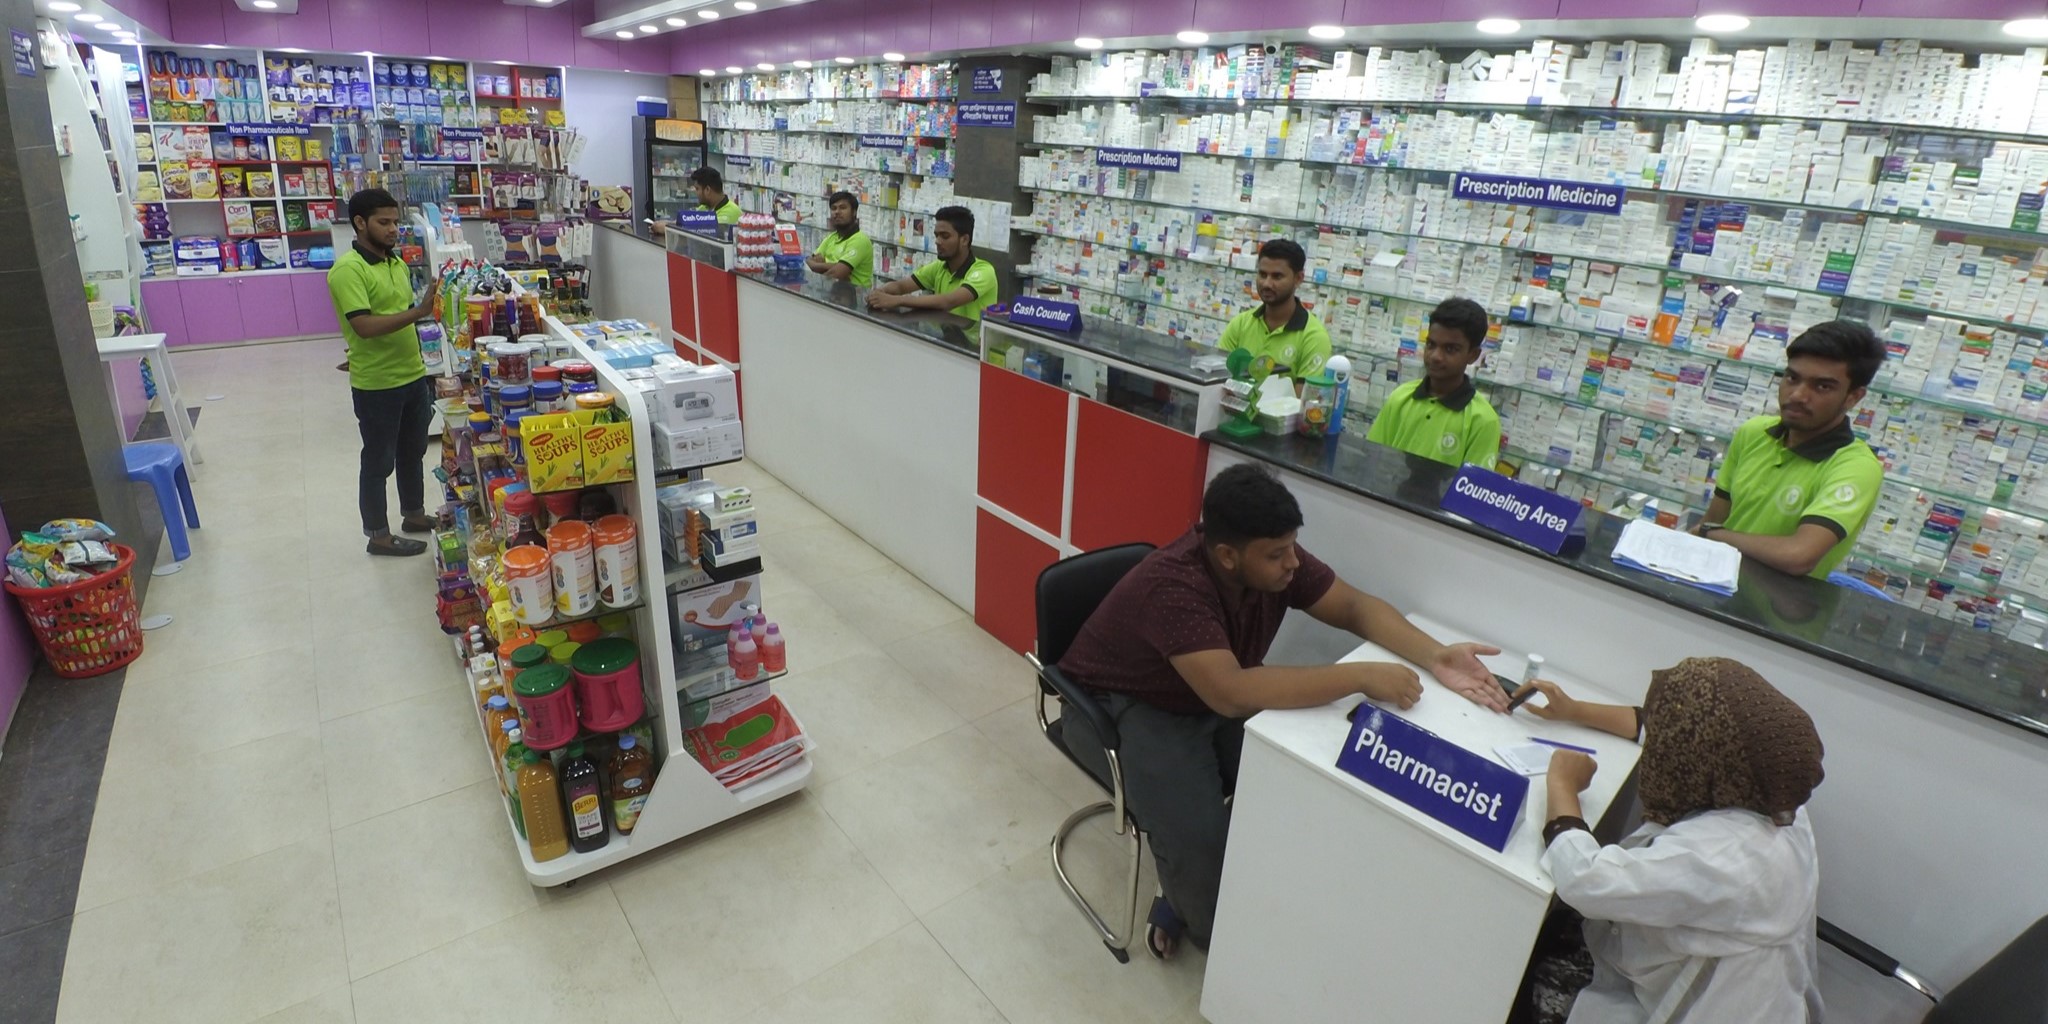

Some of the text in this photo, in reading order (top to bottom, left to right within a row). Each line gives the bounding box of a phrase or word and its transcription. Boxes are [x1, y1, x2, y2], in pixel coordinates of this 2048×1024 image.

[229, 125, 309, 135] Non Pharmaceuticals Item
[443, 129, 455, 137] Non
[862, 135, 904, 146] Prescription Medicine
[1098, 149, 1178, 167] Prescription Medicine
[1459, 176, 1617, 207] Prescription Medicine
[227, 205, 248, 215] Corn
[681, 214, 716, 222] Cash Counter
[1013, 302, 1071, 322] Cash Counter
[533, 433, 574, 456] HEALTHY
[586, 427, 627, 449] HEALTHY
[589, 434, 630, 458] SOUPS
[535, 440, 578, 465] SOUPS
[1454, 475, 1568, 533] Counseling Area
[1354, 727, 1503, 822] Pharmacist
